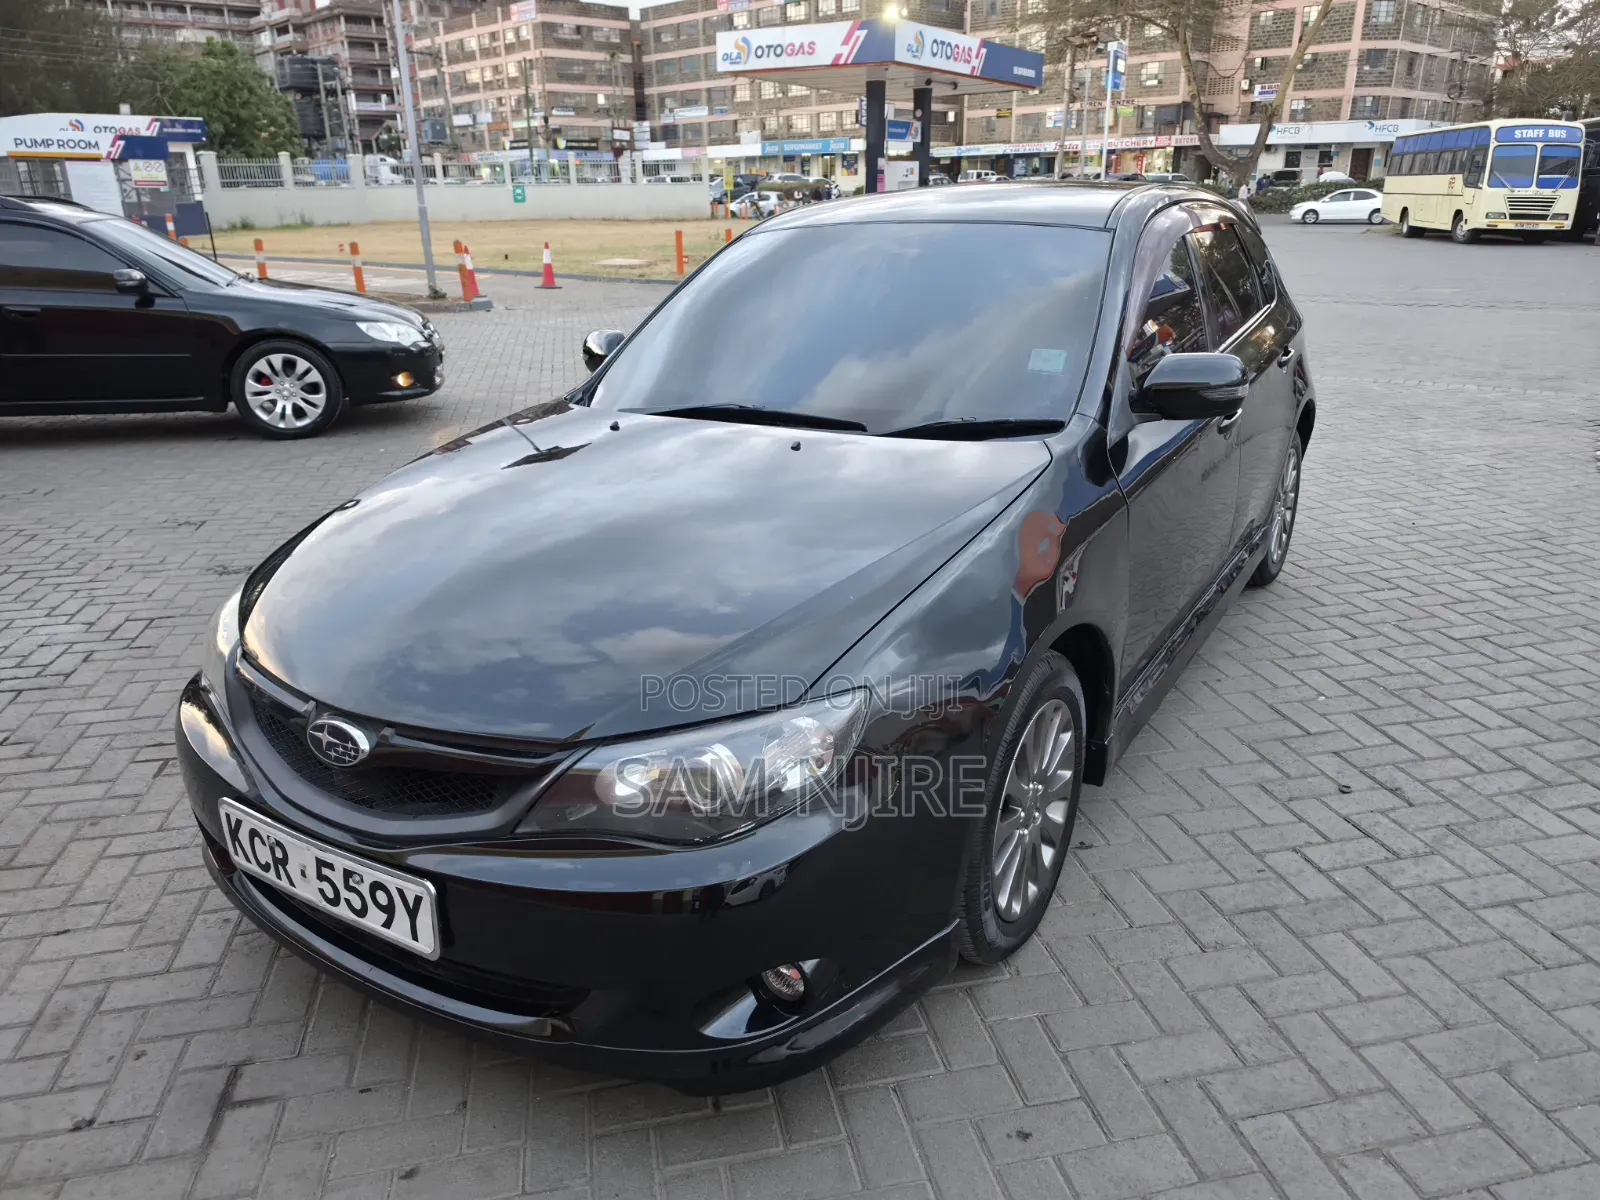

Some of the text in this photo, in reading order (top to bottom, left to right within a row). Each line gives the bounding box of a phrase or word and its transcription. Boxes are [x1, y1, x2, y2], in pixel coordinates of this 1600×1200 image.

[754, 40, 817, 59] OTOGAS
[906, 43, 919, 54] OLA
[930, 38, 973, 65] OTOGAS
[722, 51, 742, 62] OLA
[1111, 98, 1136, 106] ENTRE
[93, 125, 142, 136] OTOGAS
[1276, 126, 1301, 135] HFCB
[1374, 123, 1400, 133] HFCB
[1514, 129, 1567, 139] STAFF BUS
[13, 137, 100, 151] PUMP ROOM
[783, 142, 823, 152] SUPERMARKET
[1107, 139, 1154, 148] BUTCHERY
[225, 811, 424, 943] KCR 559Y
